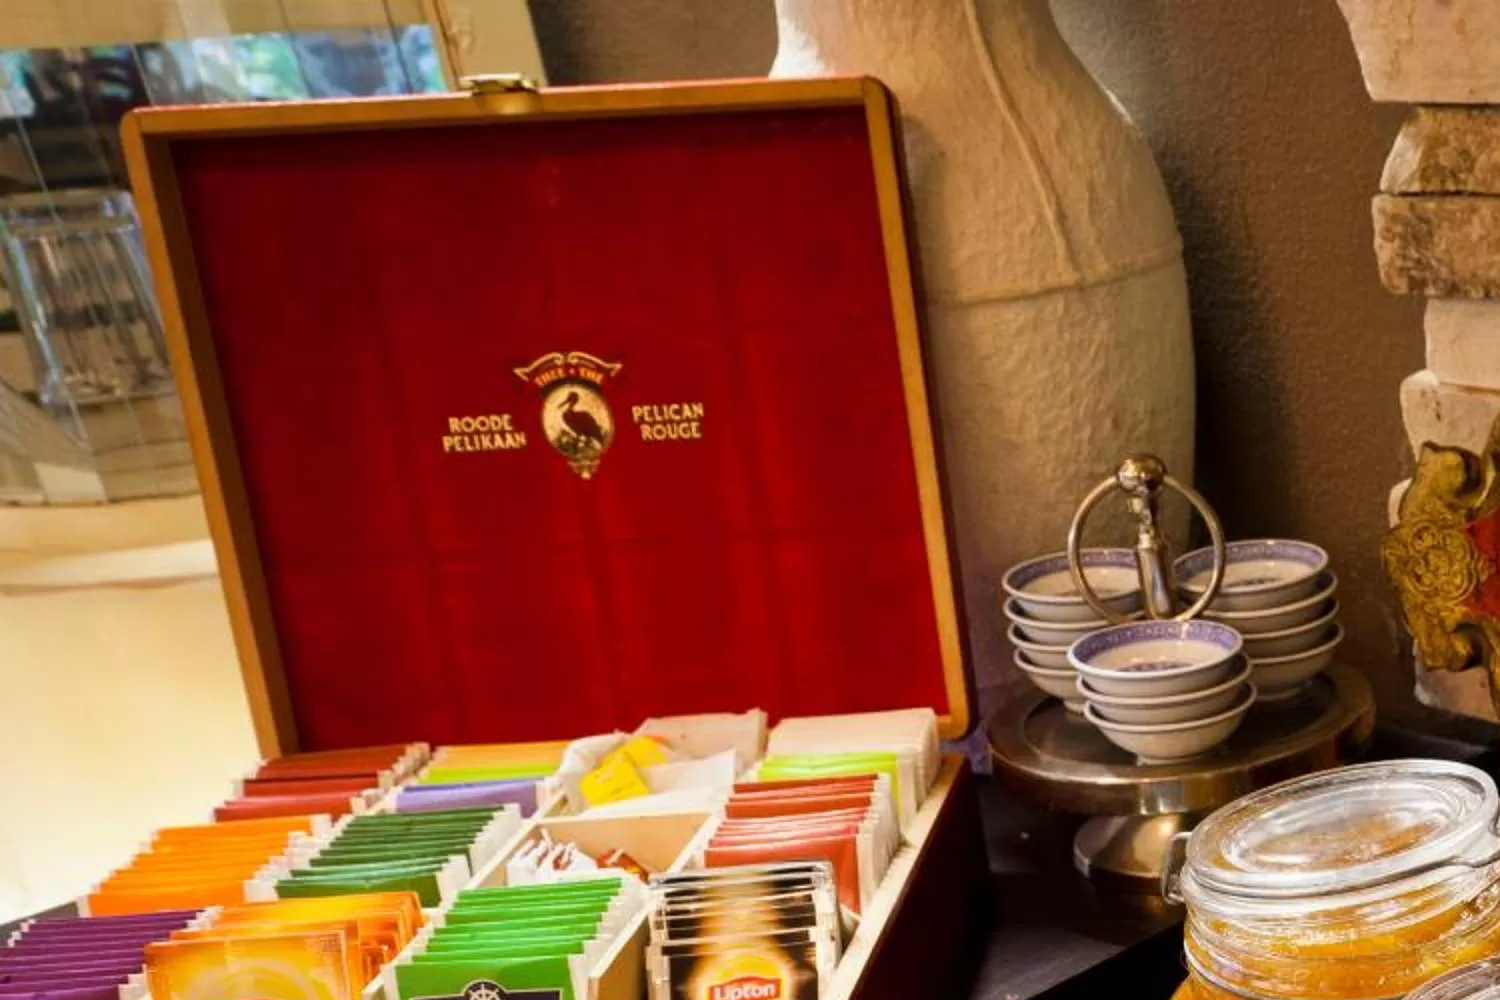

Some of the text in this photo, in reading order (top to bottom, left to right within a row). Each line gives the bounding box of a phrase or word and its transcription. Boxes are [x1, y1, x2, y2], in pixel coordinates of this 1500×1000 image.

[632, 402, 705, 423] PELICAN
[448, 414, 514, 433] ROODE
[641, 422, 702, 441] ROUGE
[442, 431, 527, 452] PELIKAAN
